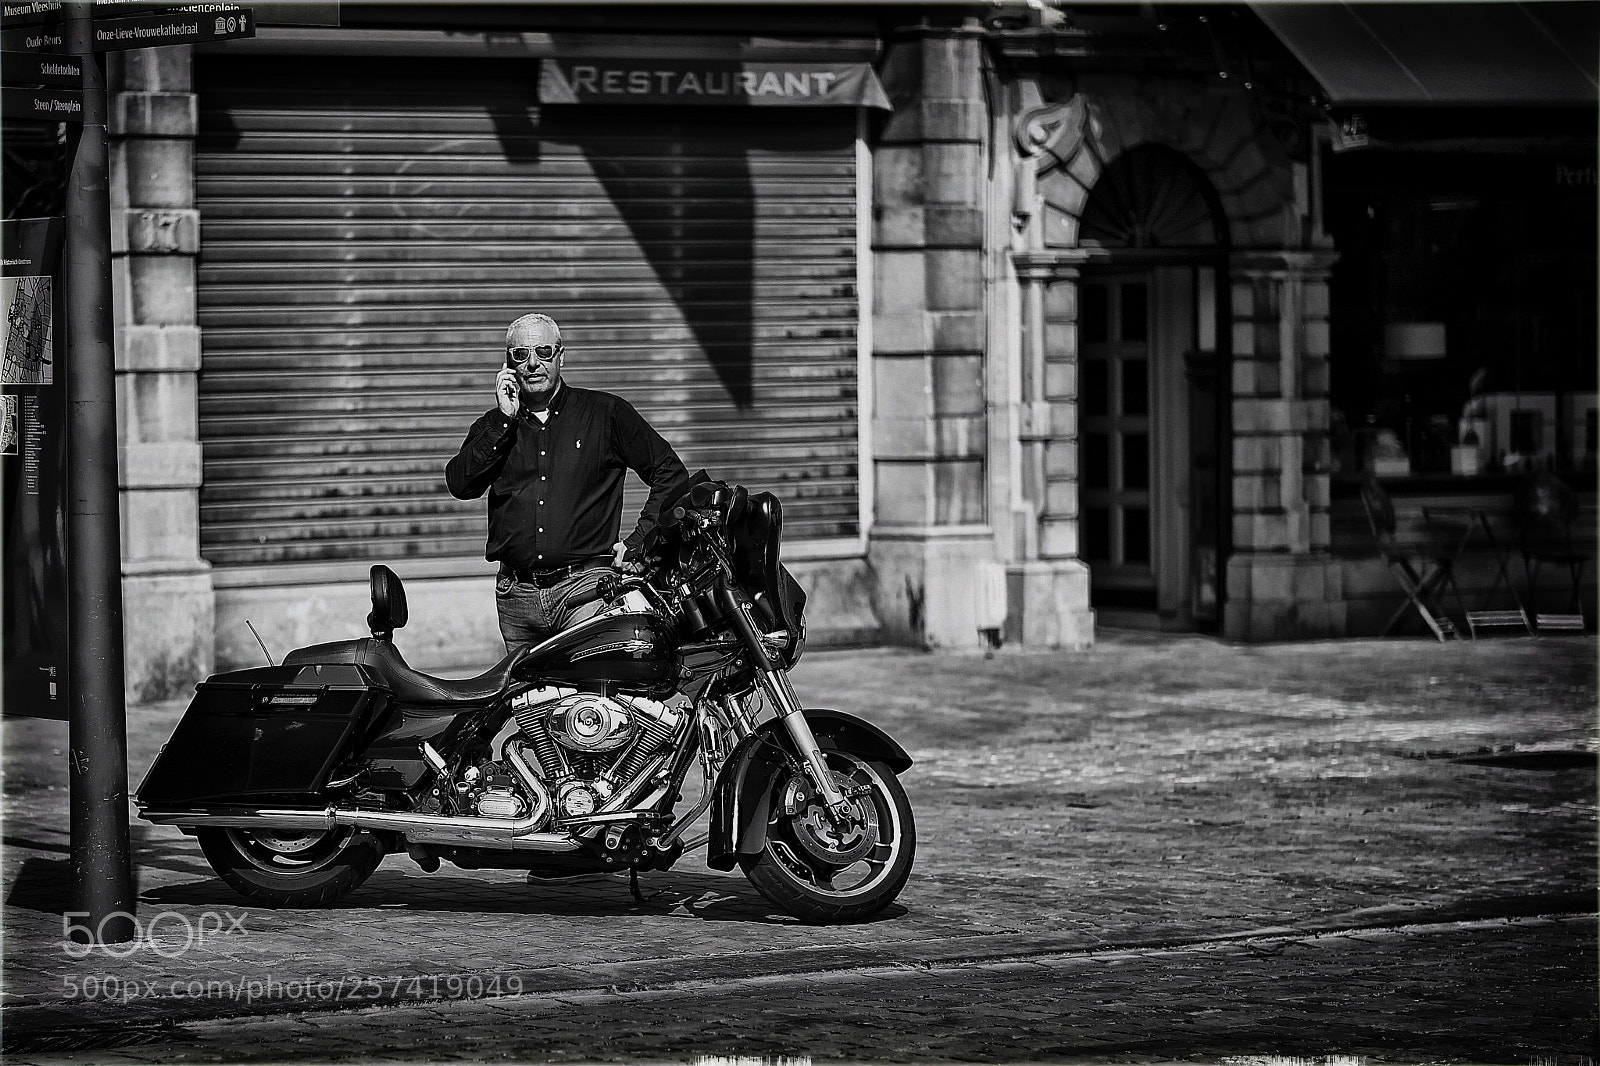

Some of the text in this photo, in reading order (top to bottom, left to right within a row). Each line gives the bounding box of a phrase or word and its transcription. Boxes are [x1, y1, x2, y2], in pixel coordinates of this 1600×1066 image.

[4, 5, 31, 17] Museum
[97, 22, 198, 40] Onze-Lieve-Vrouwekathedraal
[25, 35, 43, 48] Oude
[572, 66, 836, 97] RESTAURANT
[34, 98, 50, 110] Steen
[54, 99, 81, 114] Steenplein
